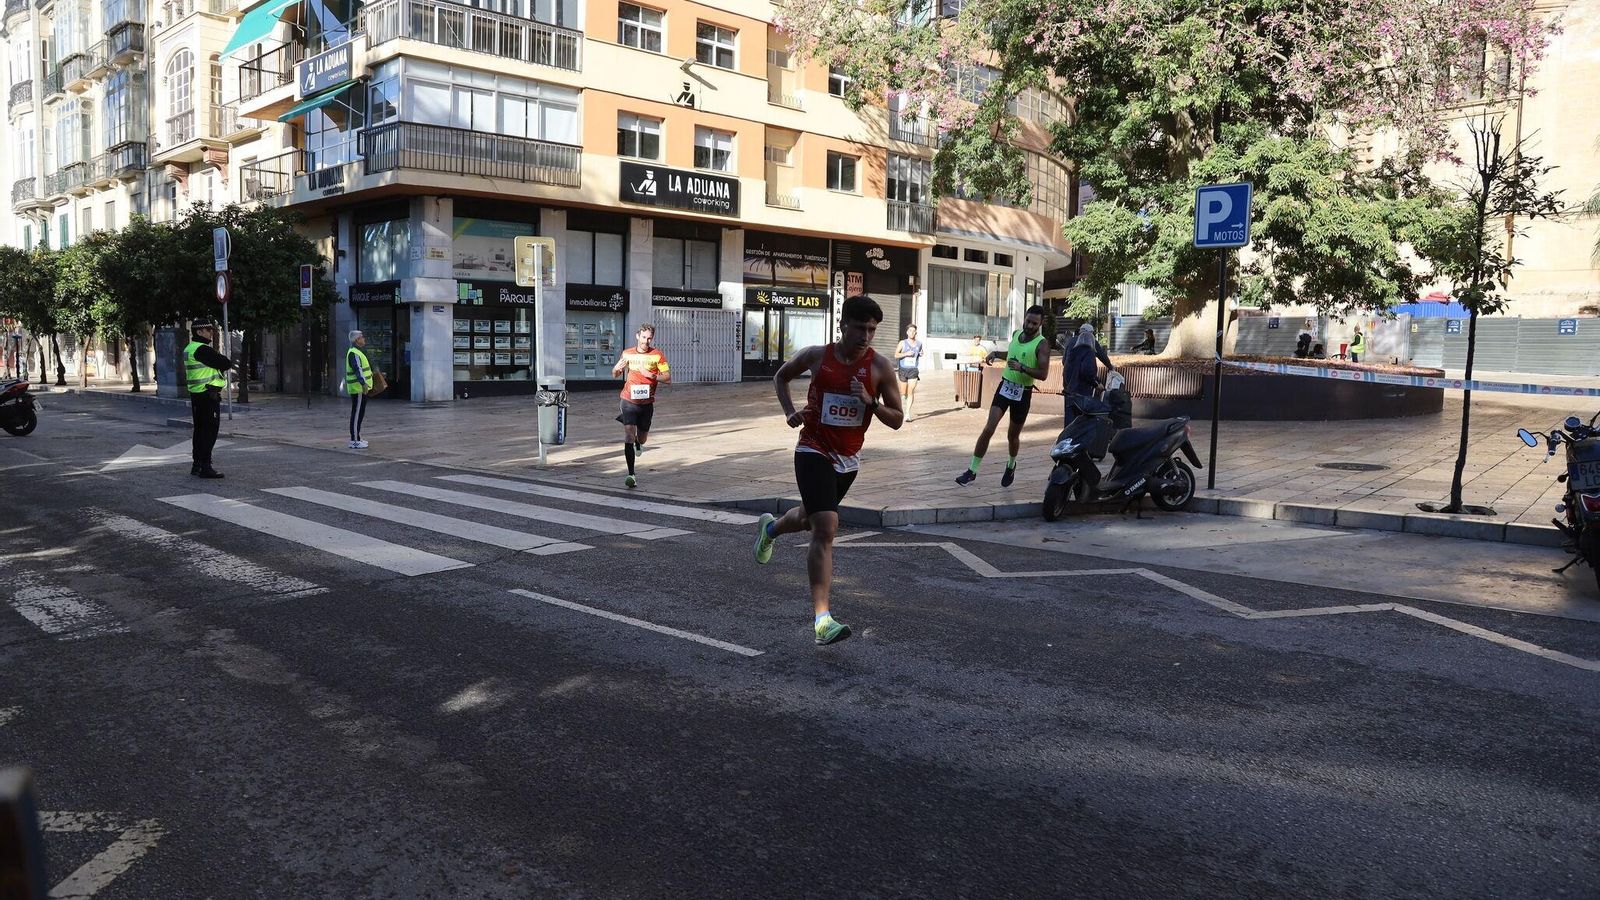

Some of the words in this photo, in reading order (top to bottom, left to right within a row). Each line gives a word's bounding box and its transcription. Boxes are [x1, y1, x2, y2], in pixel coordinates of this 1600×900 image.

[316, 58, 324, 76] LA
[324, 47, 348, 72] ADUANA
[308, 173, 317, 191] LA
[668, 174, 682, 192] LA
[686, 177, 730, 199] ADUANA
[693, 196, 730, 209] coworking
[1198, 190, 1233, 240] P
[1213, 230, 1245, 241] MOTOS
[500, 293, 535, 304] PARQUE
[652, 294, 686, 302] GESTIONAMOS
[771, 295, 795, 305] PARQUE
[797, 296, 820, 307] FLATS
[829, 405, 858, 418] 609
